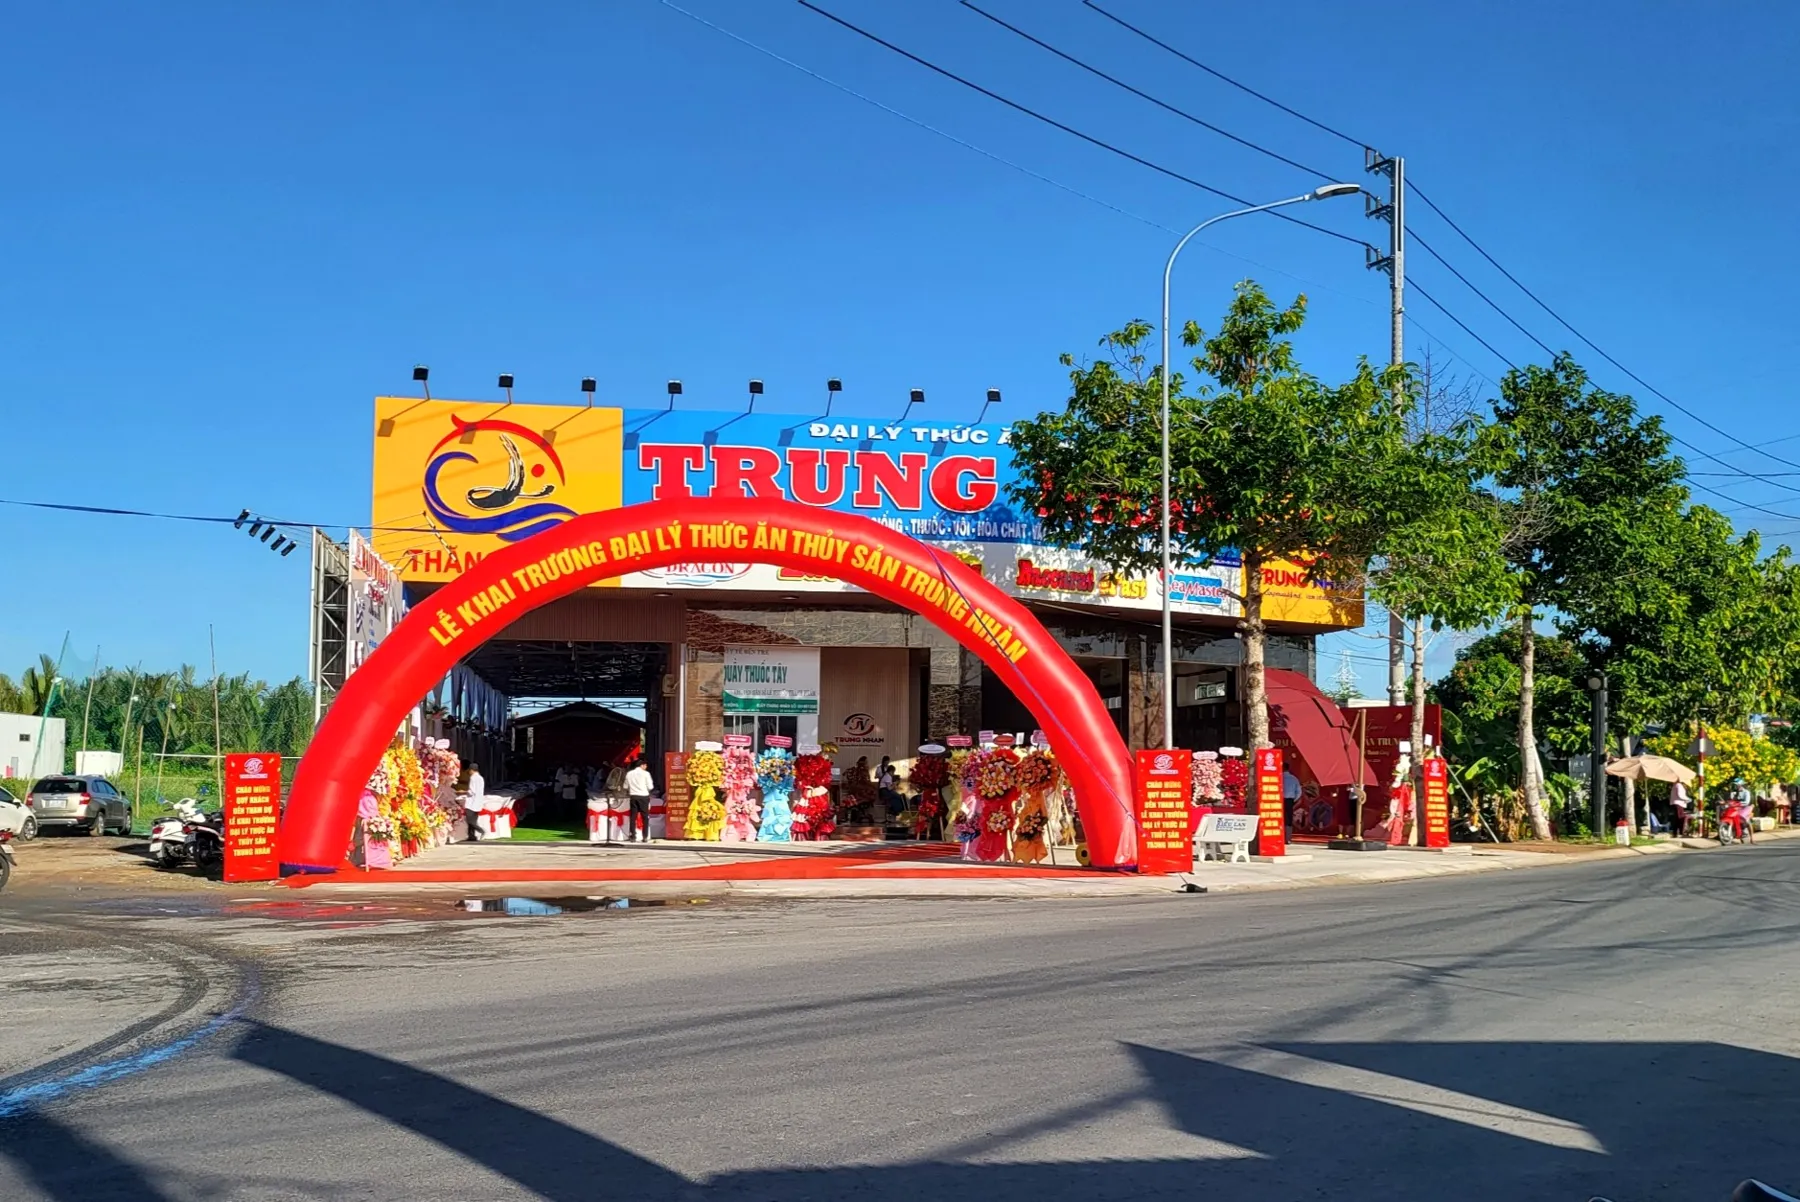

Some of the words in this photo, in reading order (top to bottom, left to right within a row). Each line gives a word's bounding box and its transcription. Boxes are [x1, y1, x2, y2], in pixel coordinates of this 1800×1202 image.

[809, 422, 859, 443] ĐẠI
[867, 421, 902, 441] LÝ
[912, 424, 989, 444] THỨC
[996, 427, 1013, 445] Ă
[638, 442, 998, 513] TRUNG
[910, 511, 946, 535] THUỐC
[952, 516, 970, 536] VÔI
[977, 517, 998, 537] HÓA
[410, 545, 482, 573] THĂN
[428, 608, 464, 647] LỄ
[456, 578, 516, 627] KHAI
[512, 541, 608, 592] TRƯƠNG
[609, 529, 652, 561] ĐẠI
[657, 519, 683, 551] LÝ
[688, 520, 749, 549] THỨC
[752, 521, 788, 552] ĂN
[792, 529, 850, 564] THỦY
[850, 543, 902, 582] SẢN
[900, 564, 970, 621] TRUNG
[745, 659, 770, 684] THUỐC
[772, 663, 788, 684] TÂY
